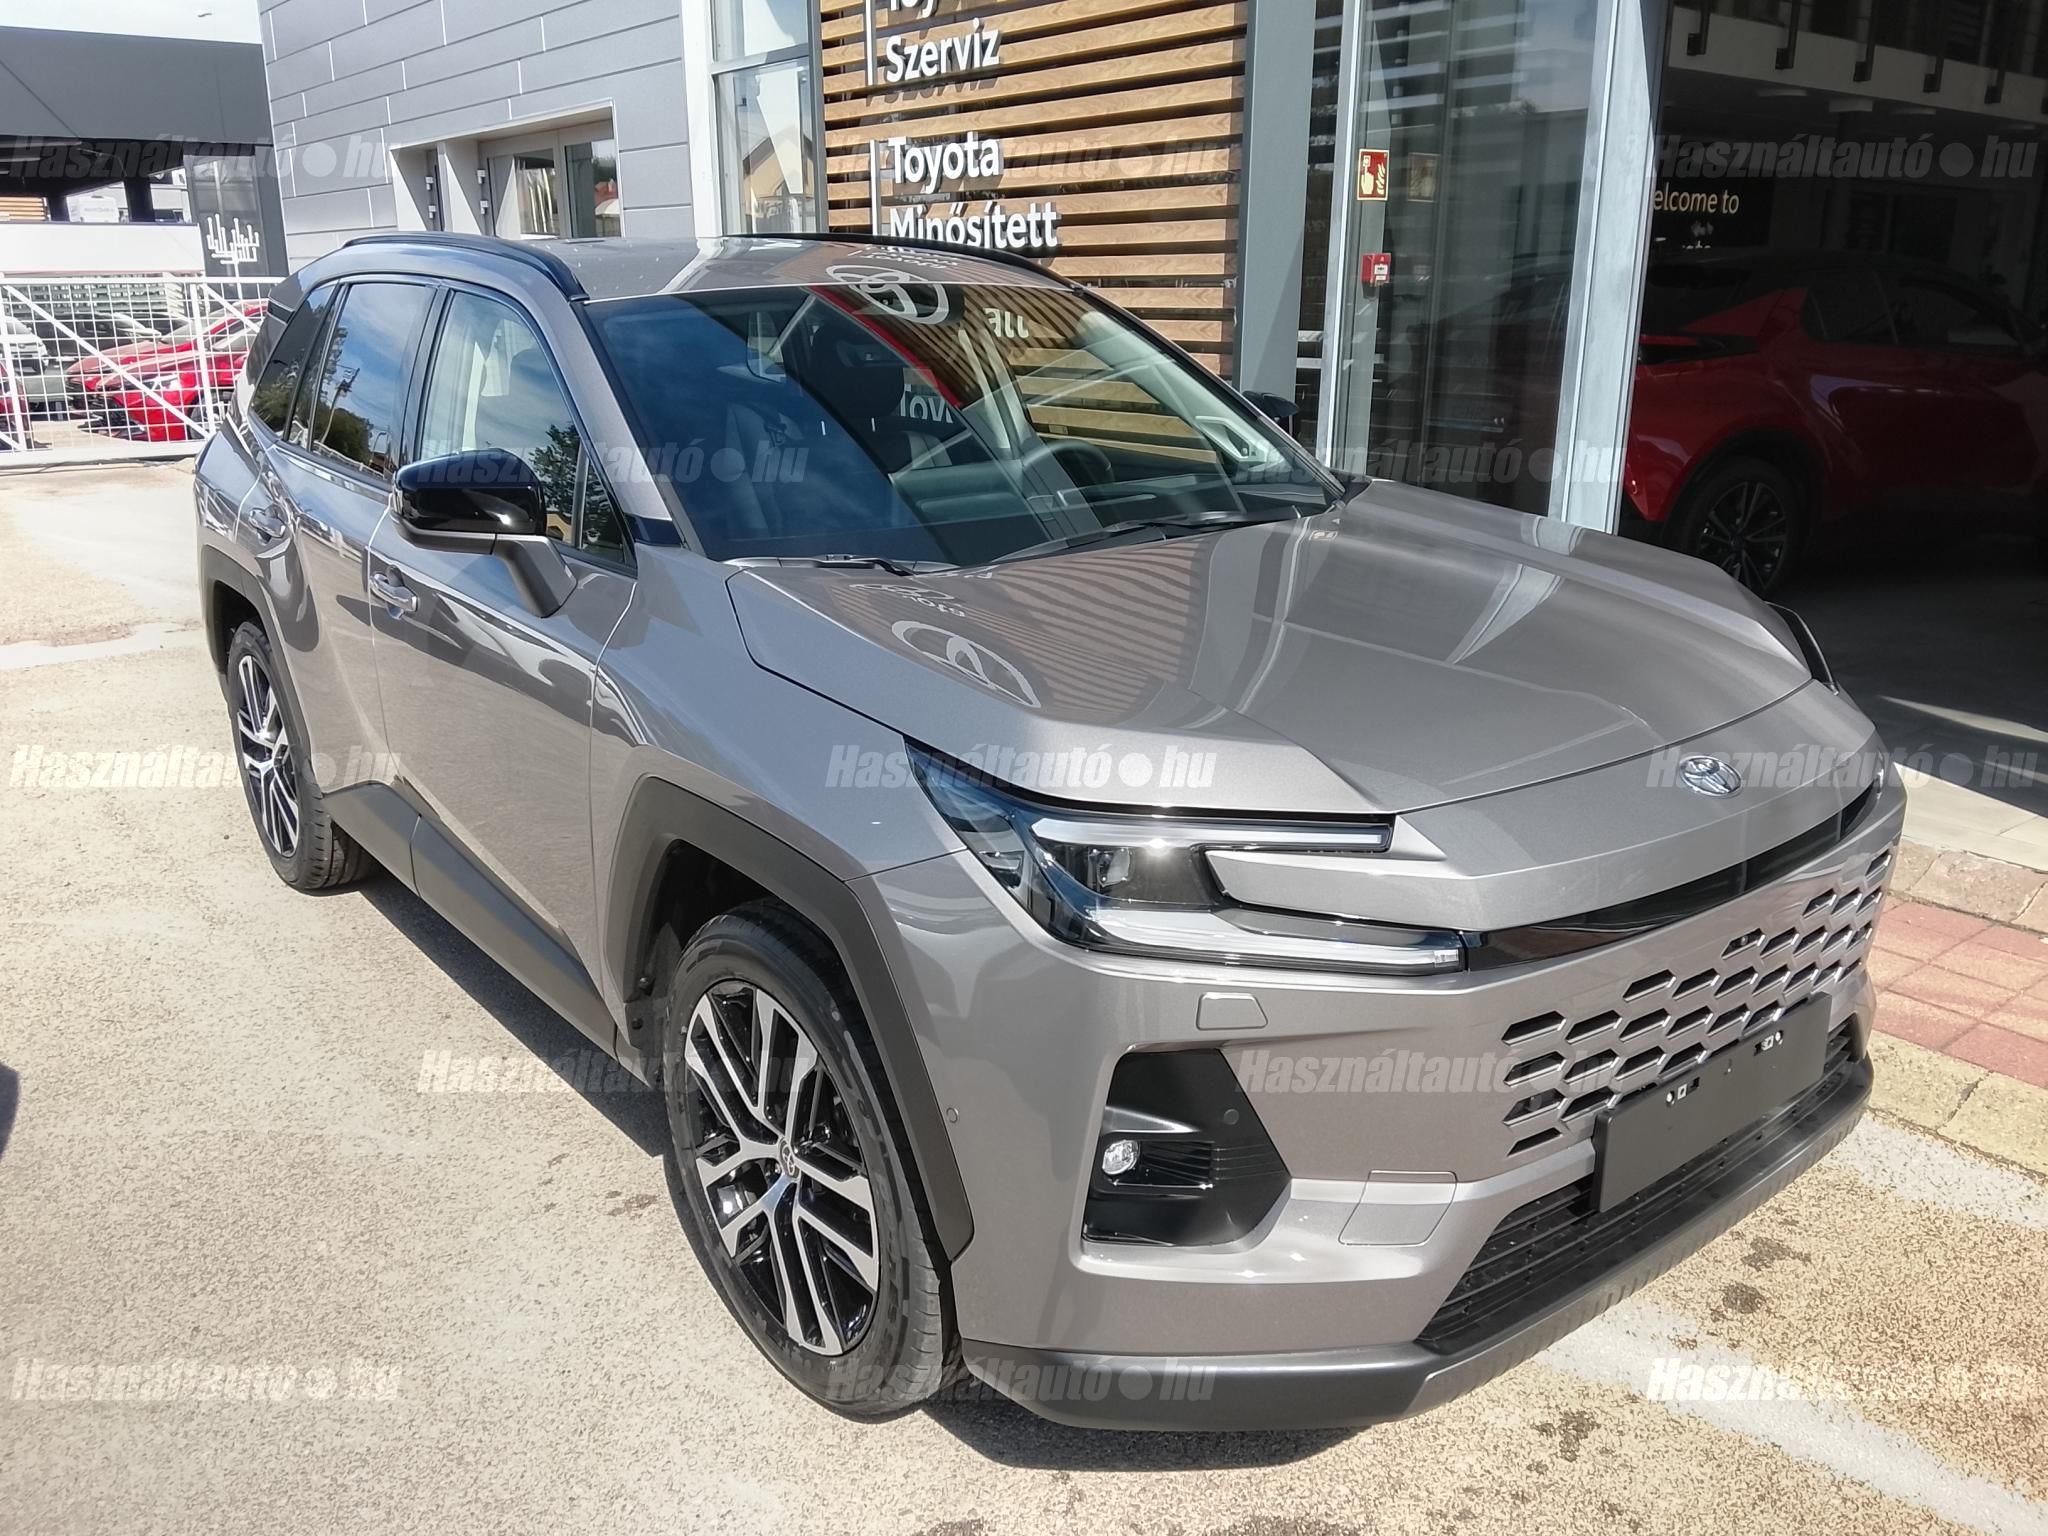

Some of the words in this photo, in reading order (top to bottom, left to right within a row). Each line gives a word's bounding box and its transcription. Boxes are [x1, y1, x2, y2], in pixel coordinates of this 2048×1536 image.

[886, 17, 999, 83] Szerviz
[888, 131, 1001, 194] Toyota
[890, 200, 1057, 249] Minősített
[1653, 182, 1718, 213] elcome
[1722, 189, 1740, 214] to
